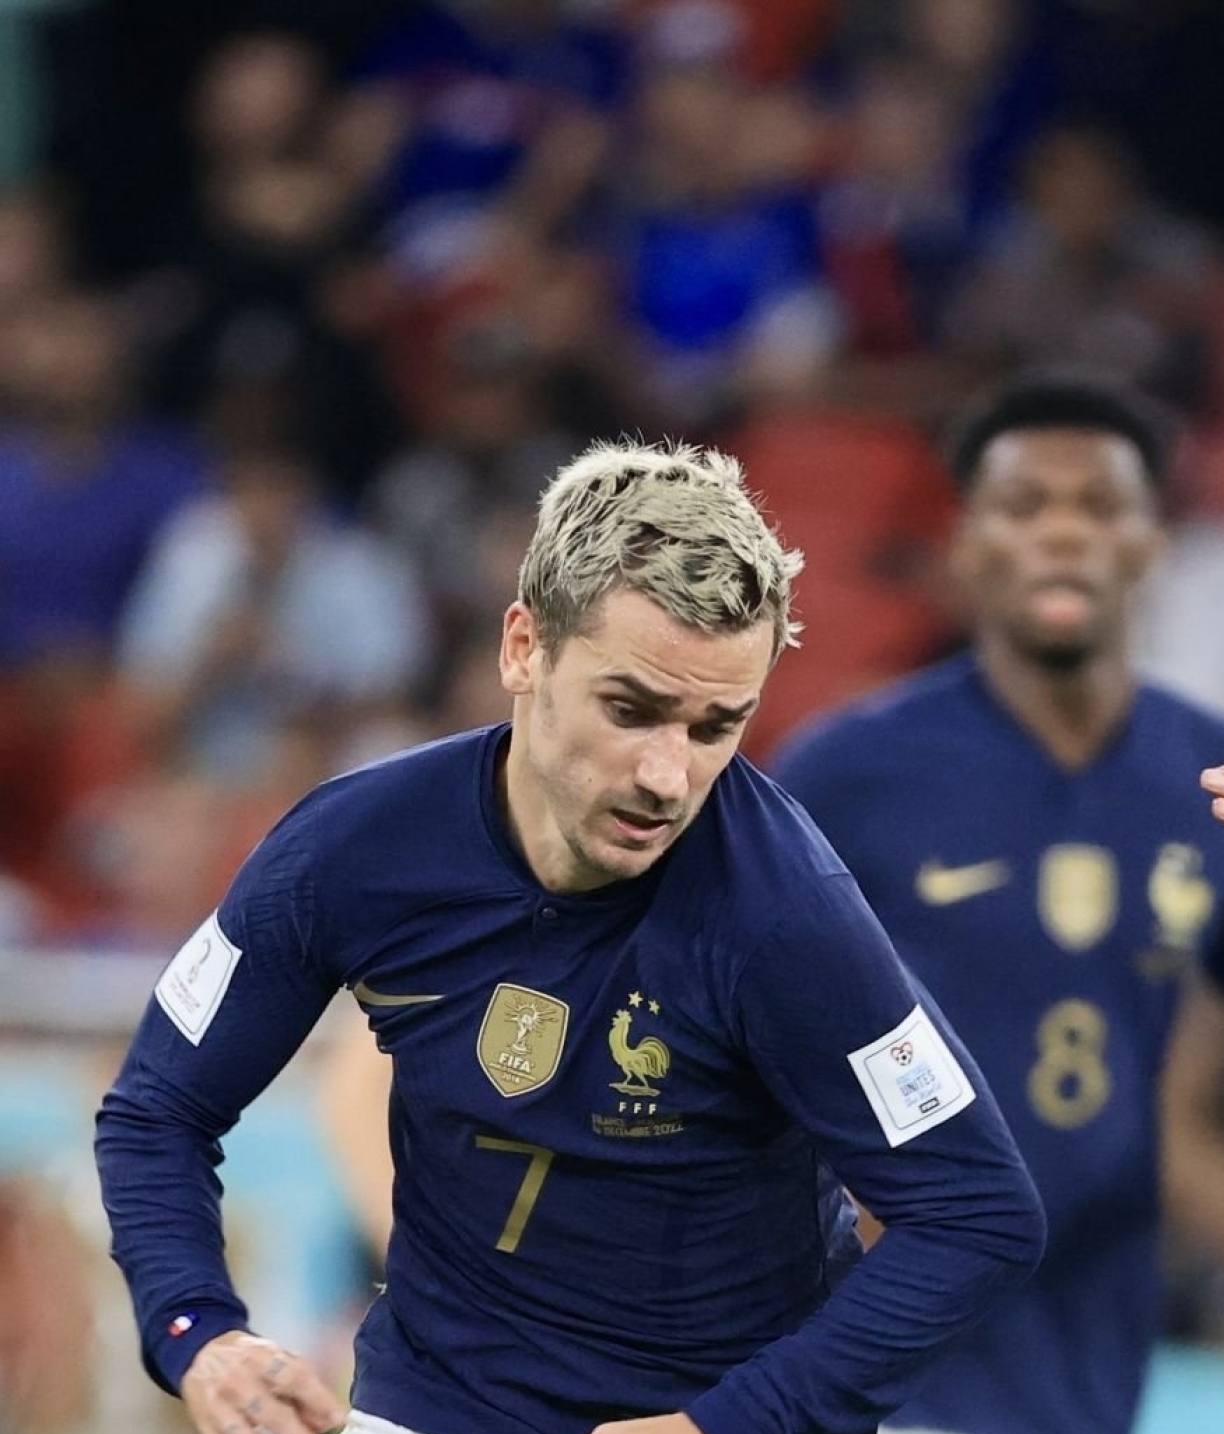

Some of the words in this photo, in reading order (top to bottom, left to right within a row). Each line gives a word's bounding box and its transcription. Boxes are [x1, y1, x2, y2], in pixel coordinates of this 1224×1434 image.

[499, 1052, 530, 1073] FIFA
[1029, 999, 1111, 1128] 8
[475, 1134, 554, 1253] 7
